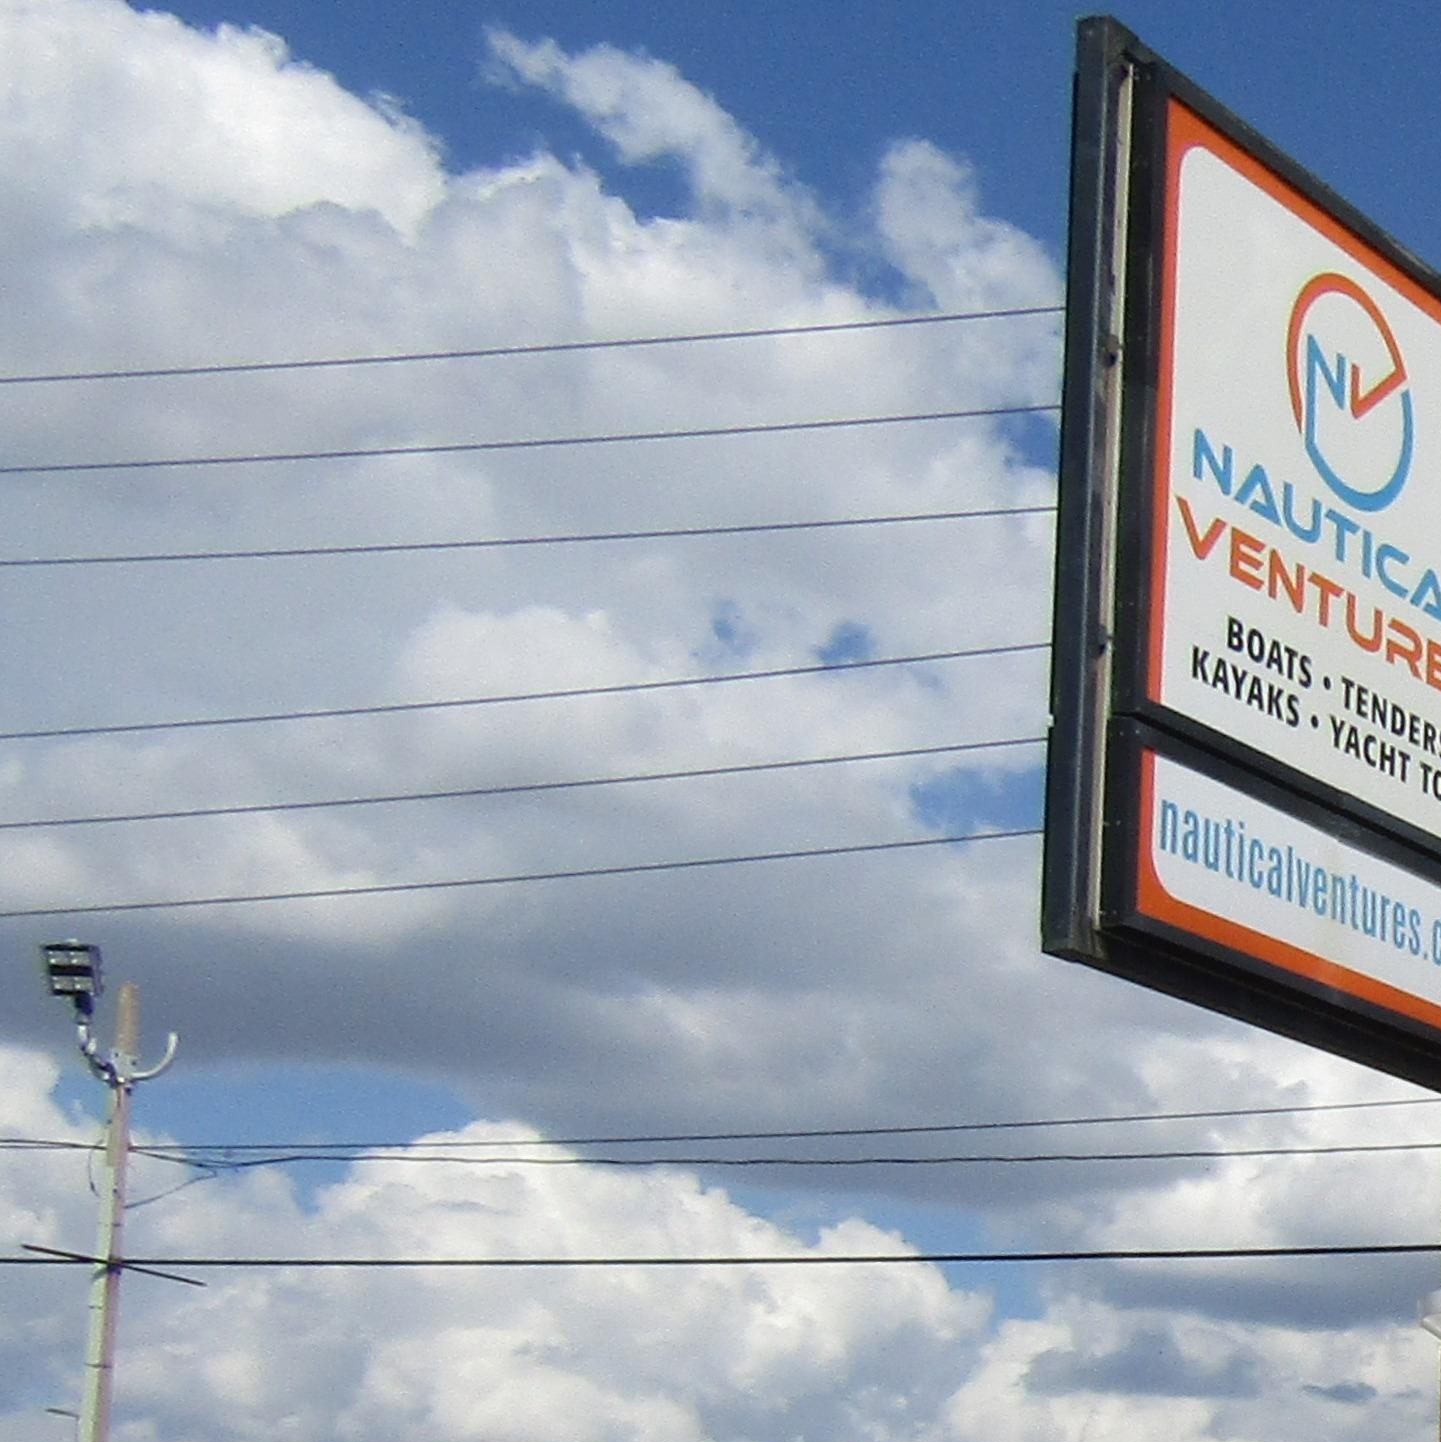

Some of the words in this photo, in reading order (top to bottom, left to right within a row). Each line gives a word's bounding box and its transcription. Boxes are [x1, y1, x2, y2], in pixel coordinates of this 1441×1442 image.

[1227, 616, 1312, 689] BOATS
[1191, 645, 1300, 728] KAYAKS
[1330, 715, 1410, 783] YACHT
